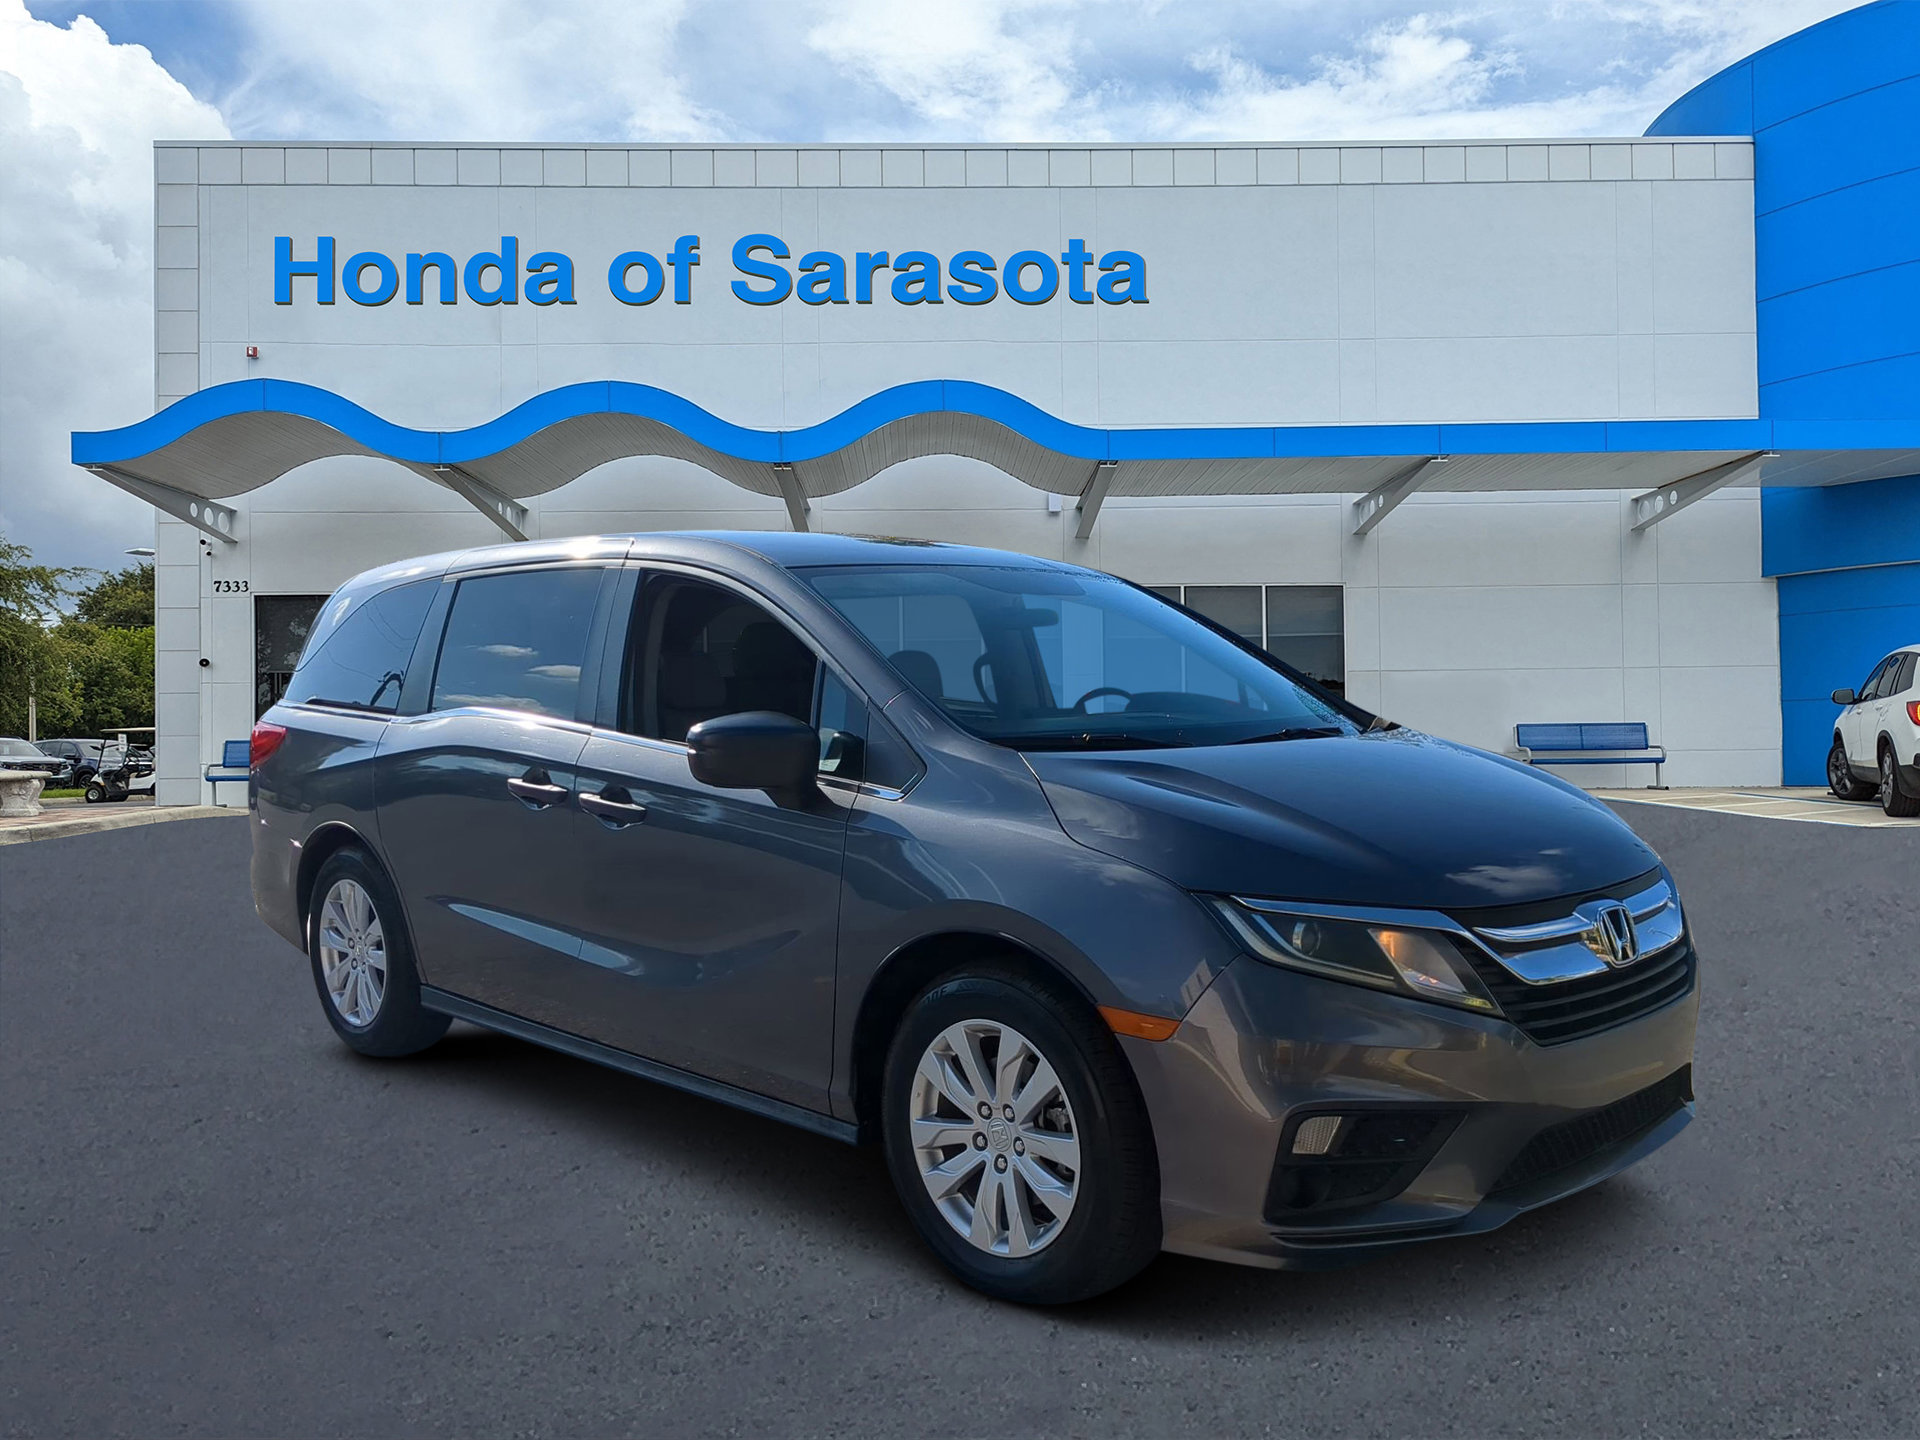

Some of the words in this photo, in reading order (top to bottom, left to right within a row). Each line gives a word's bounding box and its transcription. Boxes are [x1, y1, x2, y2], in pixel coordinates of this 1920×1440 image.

[274, 236, 577, 306] Honda
[608, 235, 700, 306] of
[731, 234, 1149, 306] Sarasota
[213, 580, 250, 593] 7333
